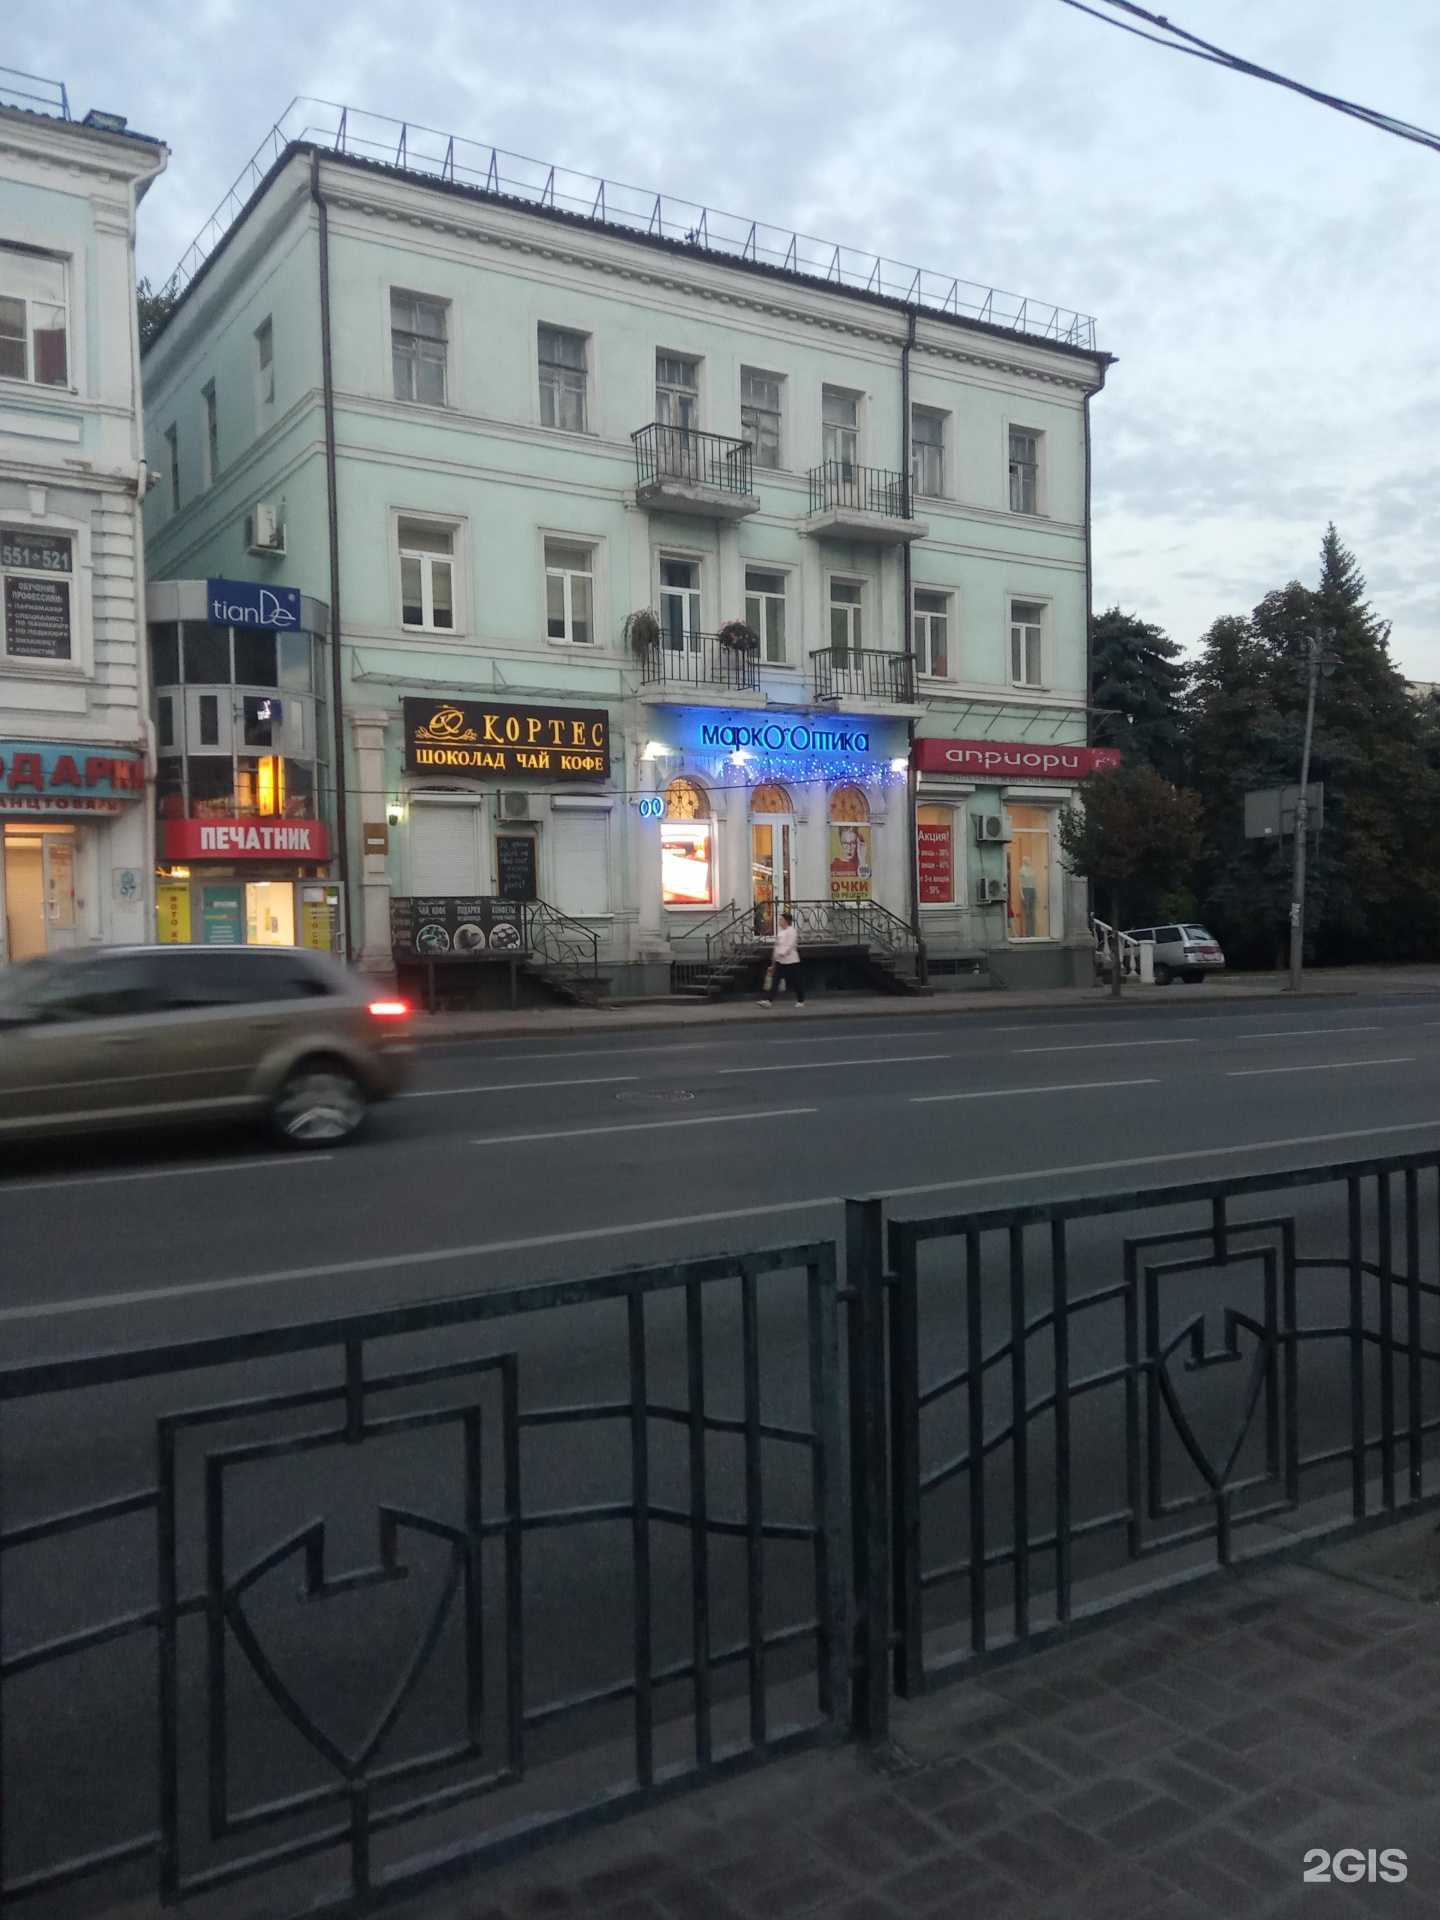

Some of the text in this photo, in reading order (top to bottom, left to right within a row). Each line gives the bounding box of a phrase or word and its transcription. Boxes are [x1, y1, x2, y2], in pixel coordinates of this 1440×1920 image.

[212, 589, 296, 627] tianDe
[482, 714, 604, 747] КОРТЕС
[415, 748, 604, 771] ШОКОЛАД ЧАЙ КОФЕ
[945, 749, 1078, 772] априори
[200, 827, 311, 850] ПЕЧАТНИК
[918, 829, 950, 844] Акция!
[832, 880, 869, 892] ОЧКИ
